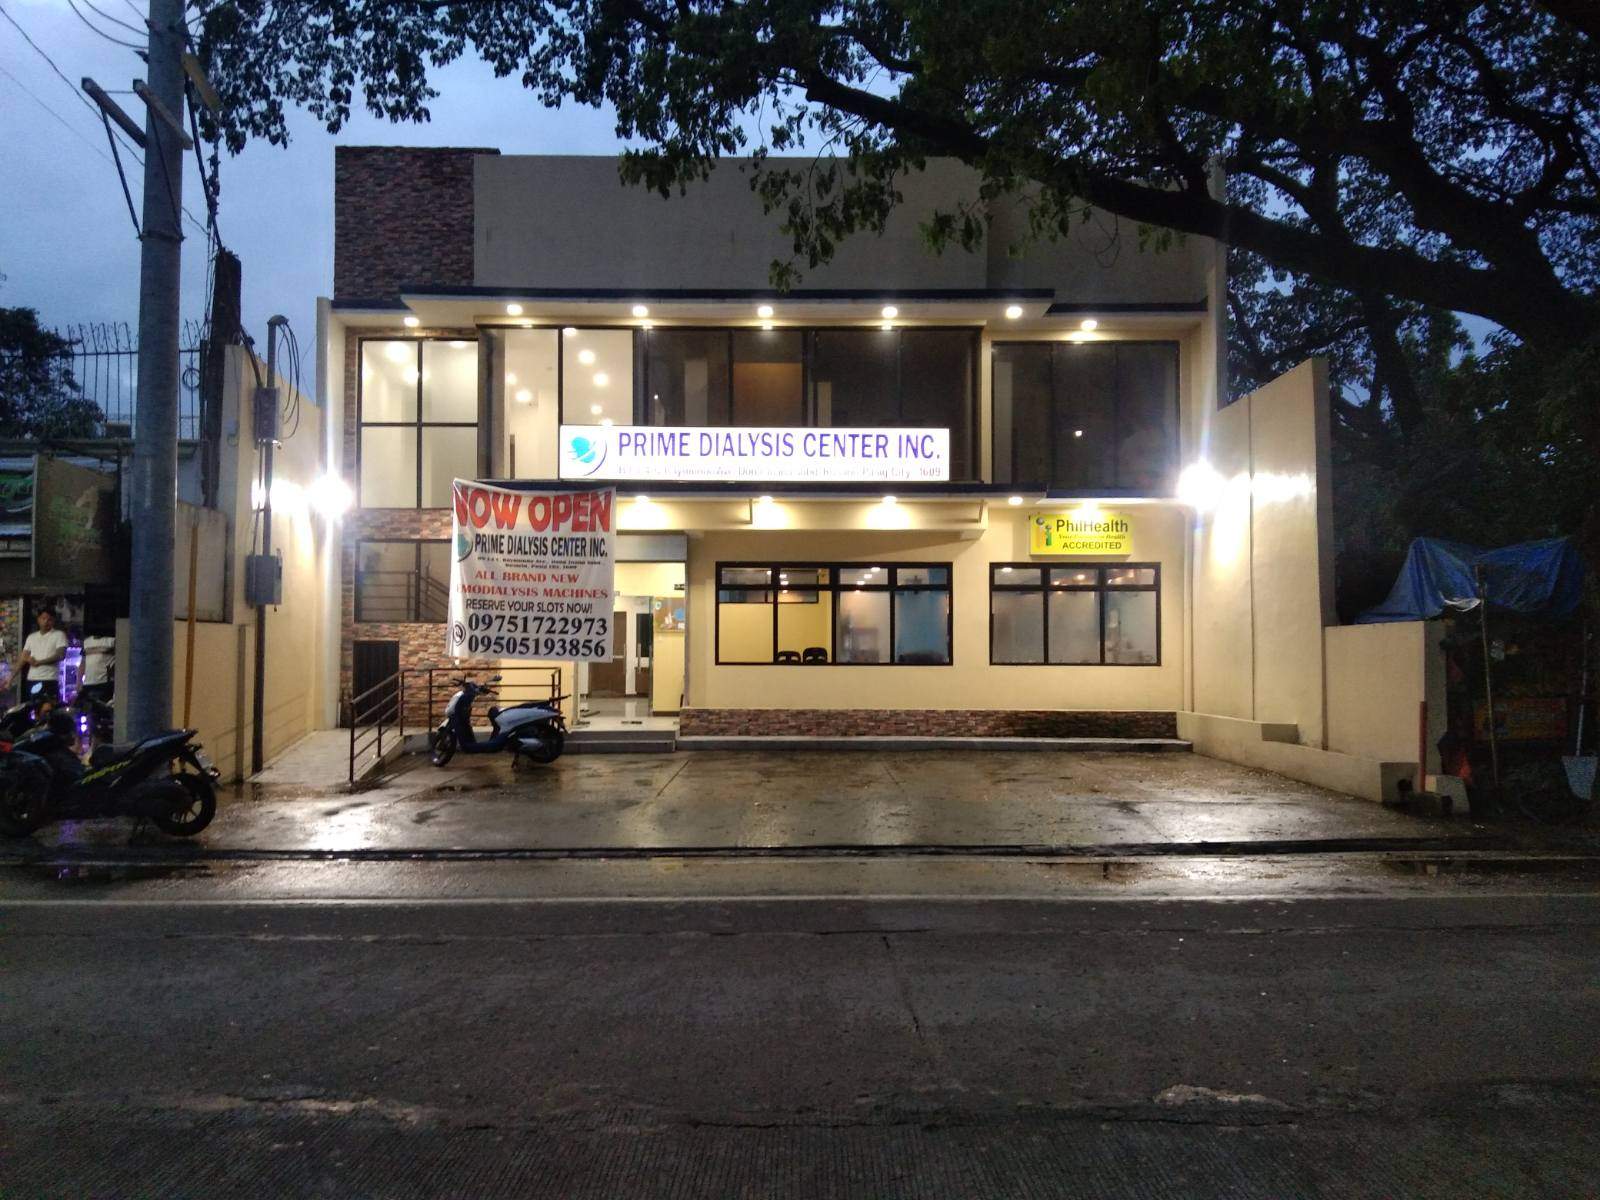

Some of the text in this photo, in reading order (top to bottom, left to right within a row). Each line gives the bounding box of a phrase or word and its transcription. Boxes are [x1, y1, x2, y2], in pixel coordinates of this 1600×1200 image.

[618, 431, 941, 460] PRIME DIALYSIS CENTER INC.
[453, 485, 612, 533] NOW OPEN
[1056, 519, 1128, 532] PhilHealth
[474, 533, 608, 558] PRIME DIALYSIS CENTER INC.
[1062, 541, 1122, 550] ACCREDITED
[475, 570, 580, 584] ALL BRAND NEW
[543, 588, 608, 599] MACHINES
[466, 598, 593, 615] RESERVE YOUR SLOTS NOW!
[468, 612, 608, 637] 09751722973
[468, 634, 606, 658] 09505193856
